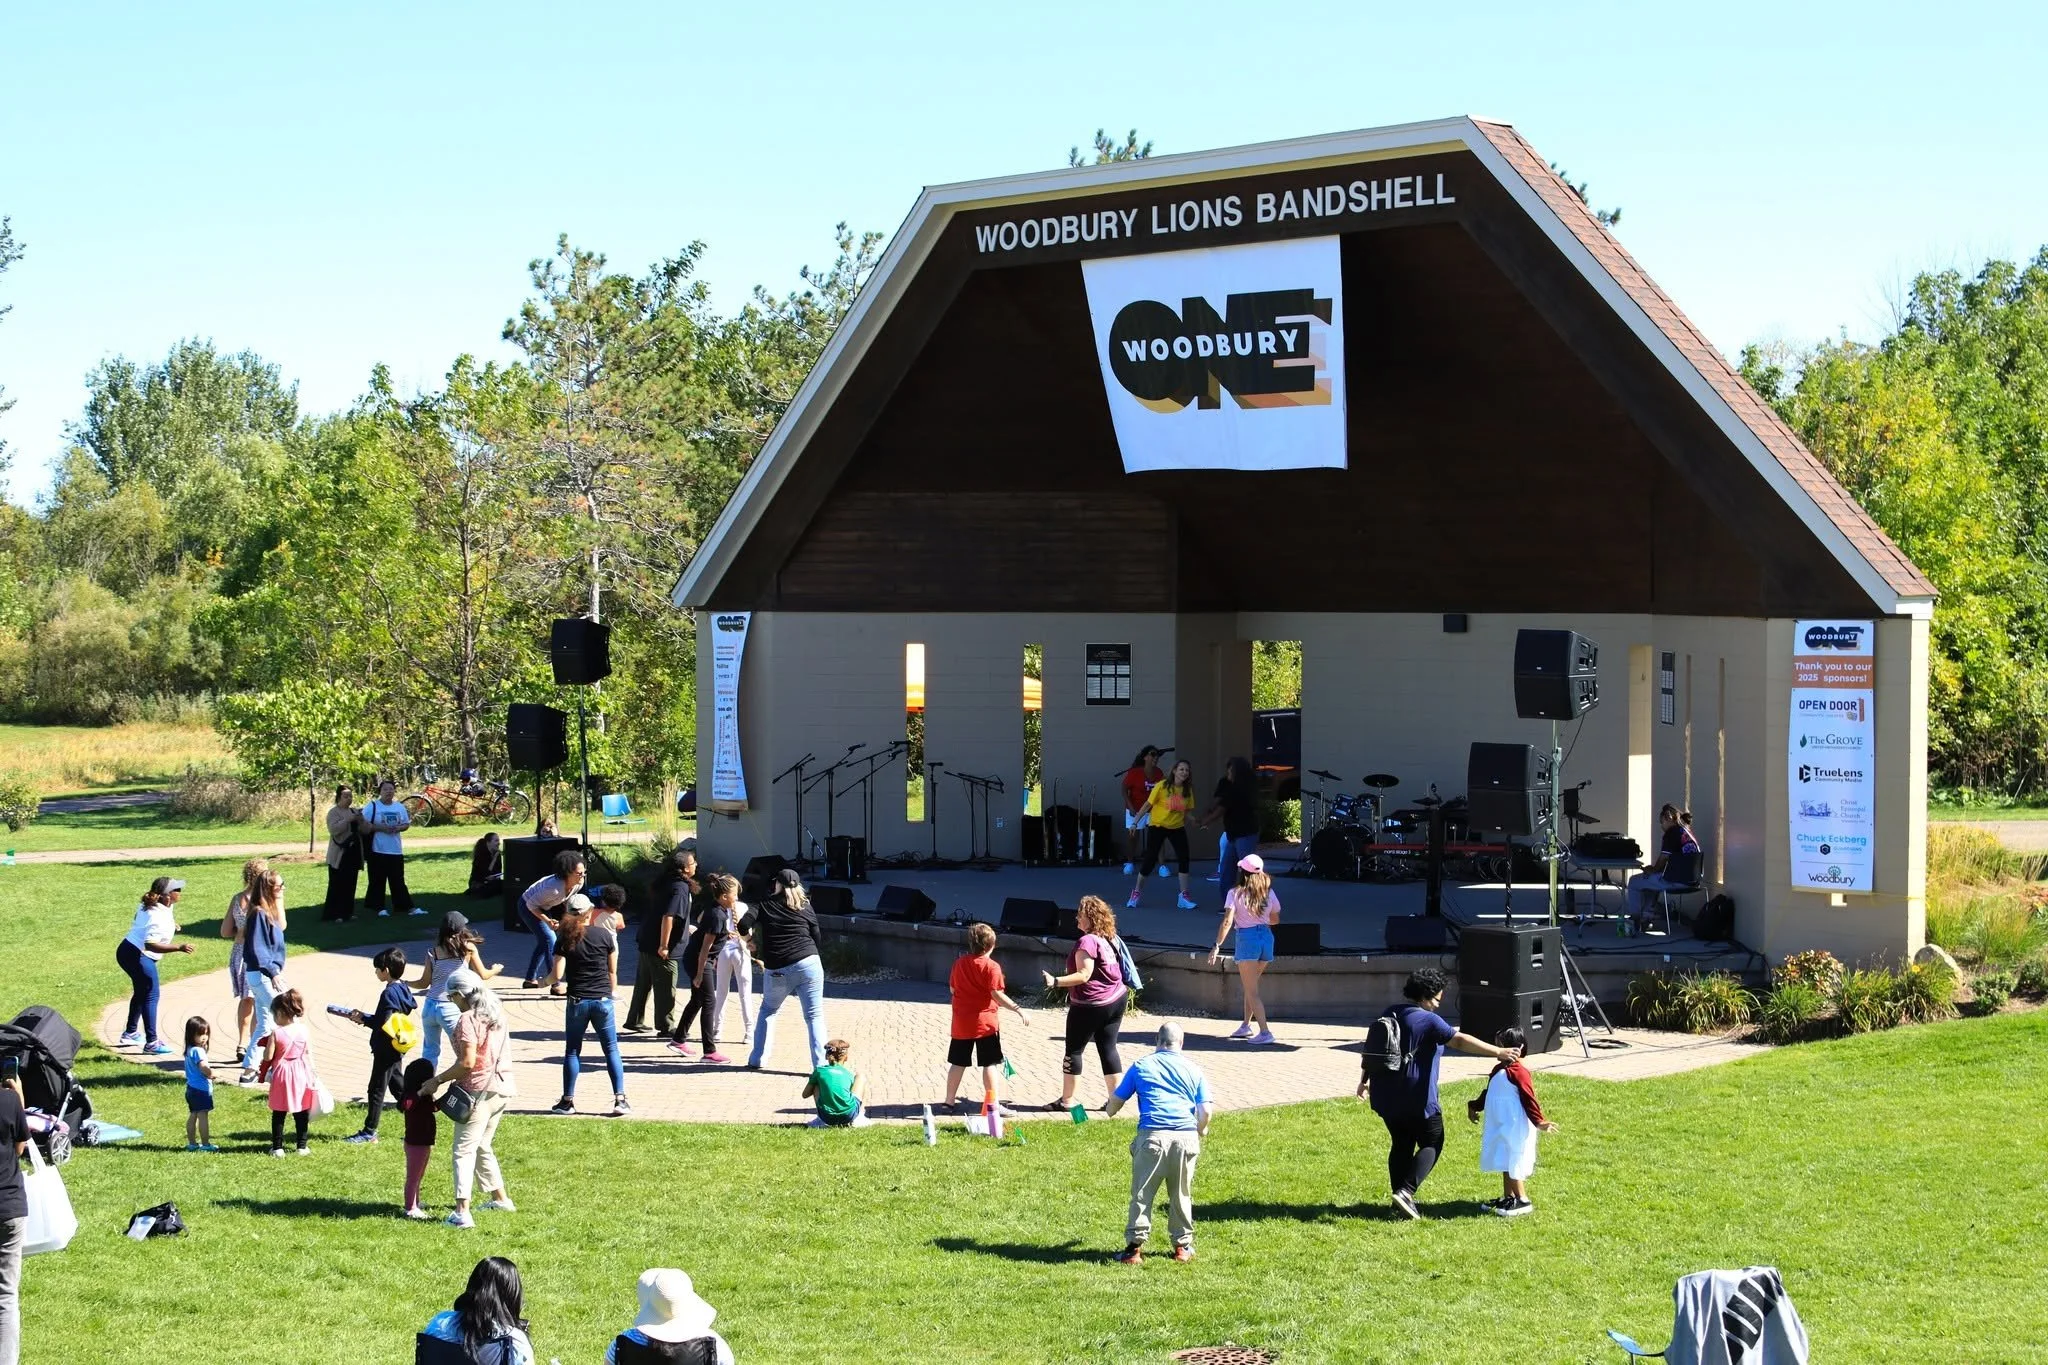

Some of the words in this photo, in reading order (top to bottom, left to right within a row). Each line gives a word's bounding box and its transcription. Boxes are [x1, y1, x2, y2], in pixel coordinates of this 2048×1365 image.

[975, 208, 1140, 254] WOODBURY
[1151, 196, 1243, 235] LIONS
[1256, 173, 1456, 223] BANDSHELL
[1109, 288, 1333, 414] ONE
[1121, 328, 1299, 362] WOODBURY
[1805, 626, 1864, 650] ONE
[1794, 662, 1823, 670] Thank
[1825, 664, 1841, 672] you
[1798, 673, 1818, 681] 2025
[1823, 675, 1867, 683] sponsors!
[1799, 700, 1827, 710] OPEN
[1829, 701, 1857, 711] DOOR
[1813, 767, 1863, 777] TrueLens
[1796, 834, 1826, 842] Chuck
[1828, 835, 1867, 846] Eckberg
[1808, 872, 1855, 886] woodbury
